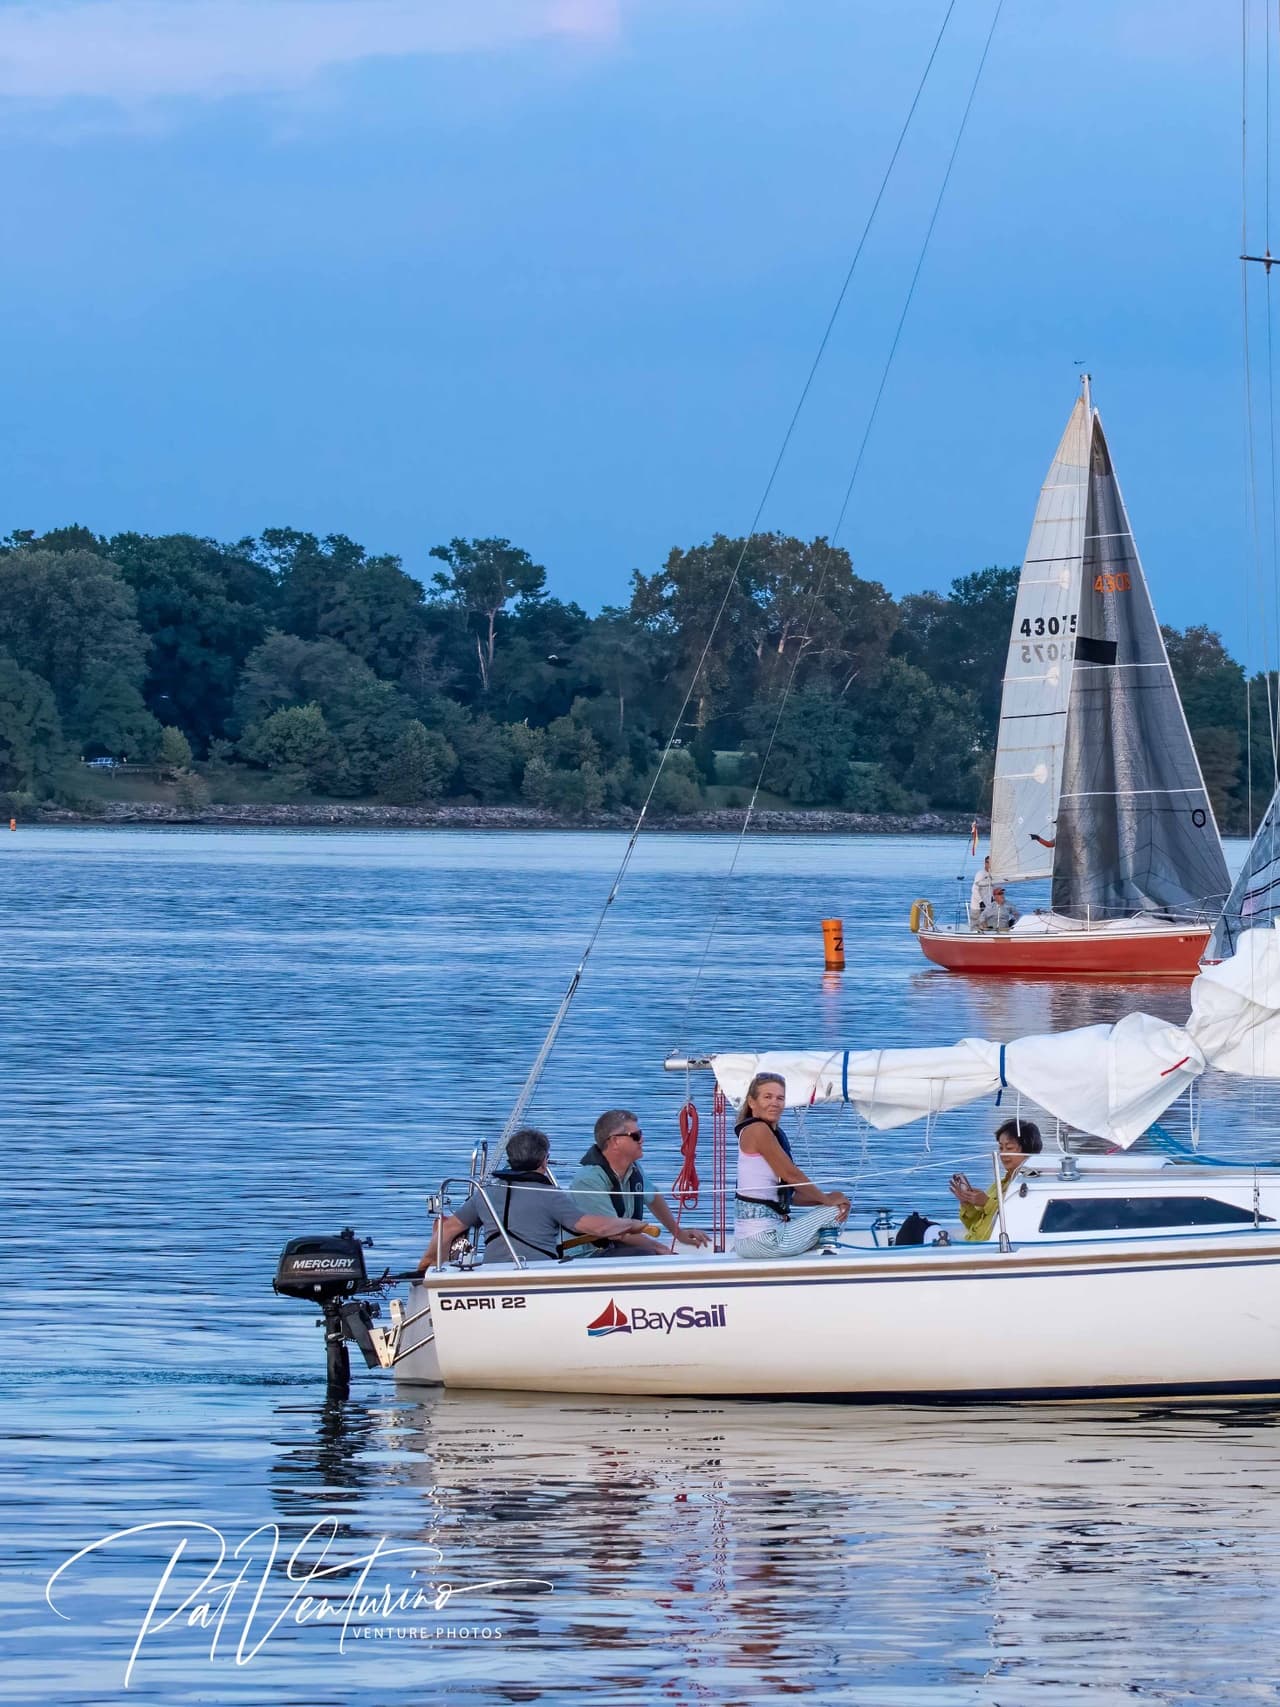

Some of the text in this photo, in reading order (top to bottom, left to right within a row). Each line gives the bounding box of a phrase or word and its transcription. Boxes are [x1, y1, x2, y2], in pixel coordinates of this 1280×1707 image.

[292, 1258, 354, 1269] MERCURY
[440, 1297, 527, 1311] CAPRI 22
[631, 1304, 727, 1334] BaySail
